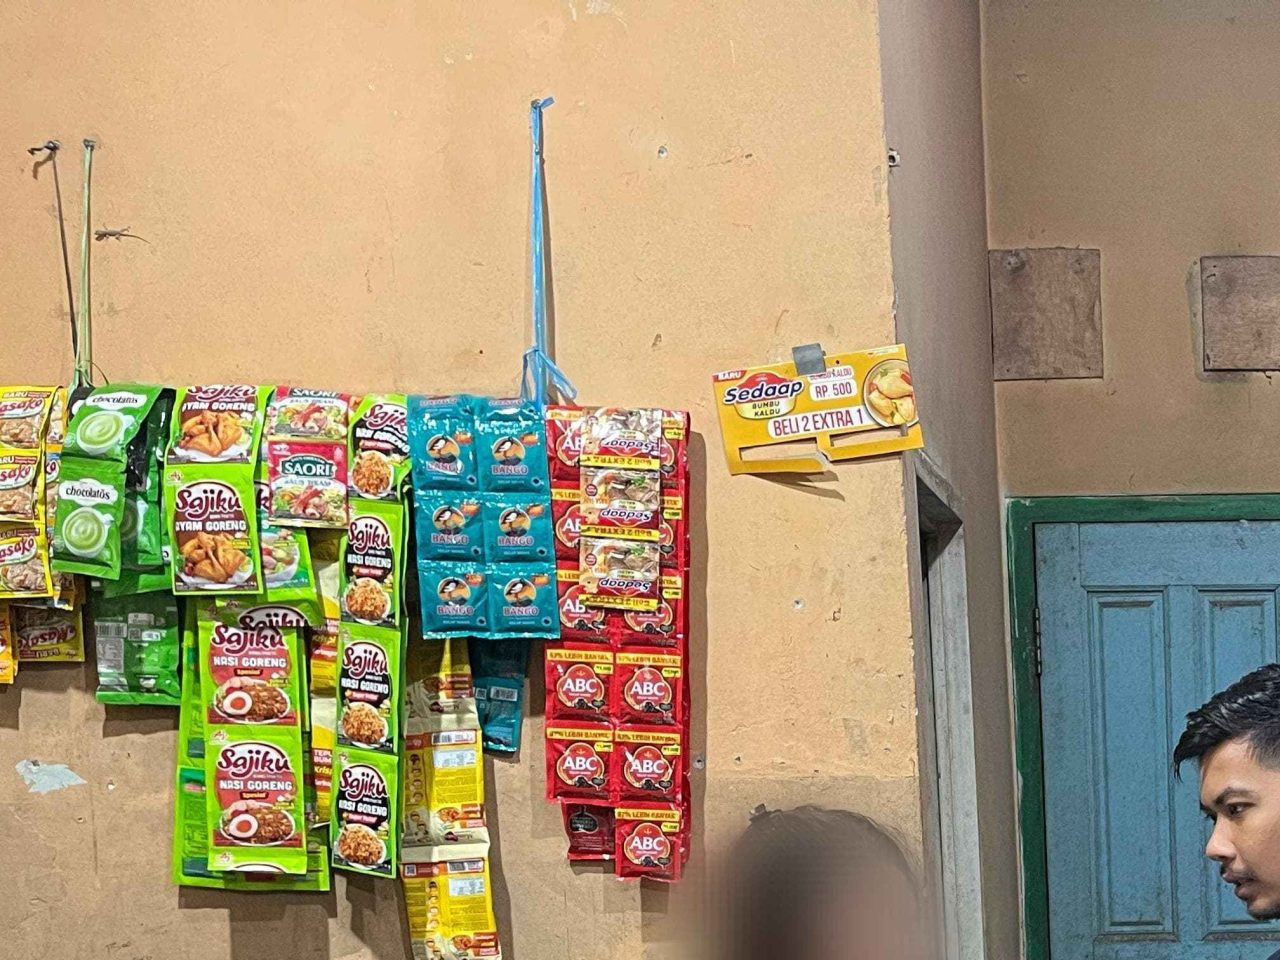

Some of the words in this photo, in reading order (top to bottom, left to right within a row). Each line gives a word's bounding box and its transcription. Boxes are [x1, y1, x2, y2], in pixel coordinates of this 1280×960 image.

[718, 371, 741, 380] BARU
[725, 381, 802, 402] Sedaap
[833, 382, 852, 396] 500
[0, 399, 42, 412] asako
[212, 402, 255, 411] GORENG
[752, 400, 780, 409] BUMBU
[754, 408, 781, 417] KALDU
[774, 417, 799, 436] BELI
[803, 415, 811, 431] 2
[814, 409, 852, 430] EXTRA
[857, 409, 863, 424] 1
[284, 463, 332, 476] SAORI
[492, 464, 528, 475] BANGO
[176, 489, 242, 519] Sajiku
[601, 509, 652, 521] Sedaap
[206, 520, 246, 531] GORENG
[349, 522, 390, 554] Sajiku
[431, 535, 469, 544] BANGO
[498, 536, 533, 546] BANGO
[0, 537, 34, 558] asako
[600, 578, 651, 591] Sedaap
[437, 606, 474, 615] BANGO
[503, 607, 539, 616] BANGO
[212, 624, 285, 654] Sajiku
[214, 656, 238, 666] NASI
[242, 658, 287, 667] GORENG
[342, 647, 388, 678] Sajiku
[563, 678, 597, 692] ABC
[631, 682, 665, 696] ABC
[217, 749, 290, 778] Sajiku
[563, 757, 597, 771] ABC
[631, 760, 665, 774] ABC
[220, 780, 244, 790] NASI
[247, 780, 292, 790] GORENG
[340, 769, 387, 800] Sajiku
[630, 836, 664, 850] ABC
